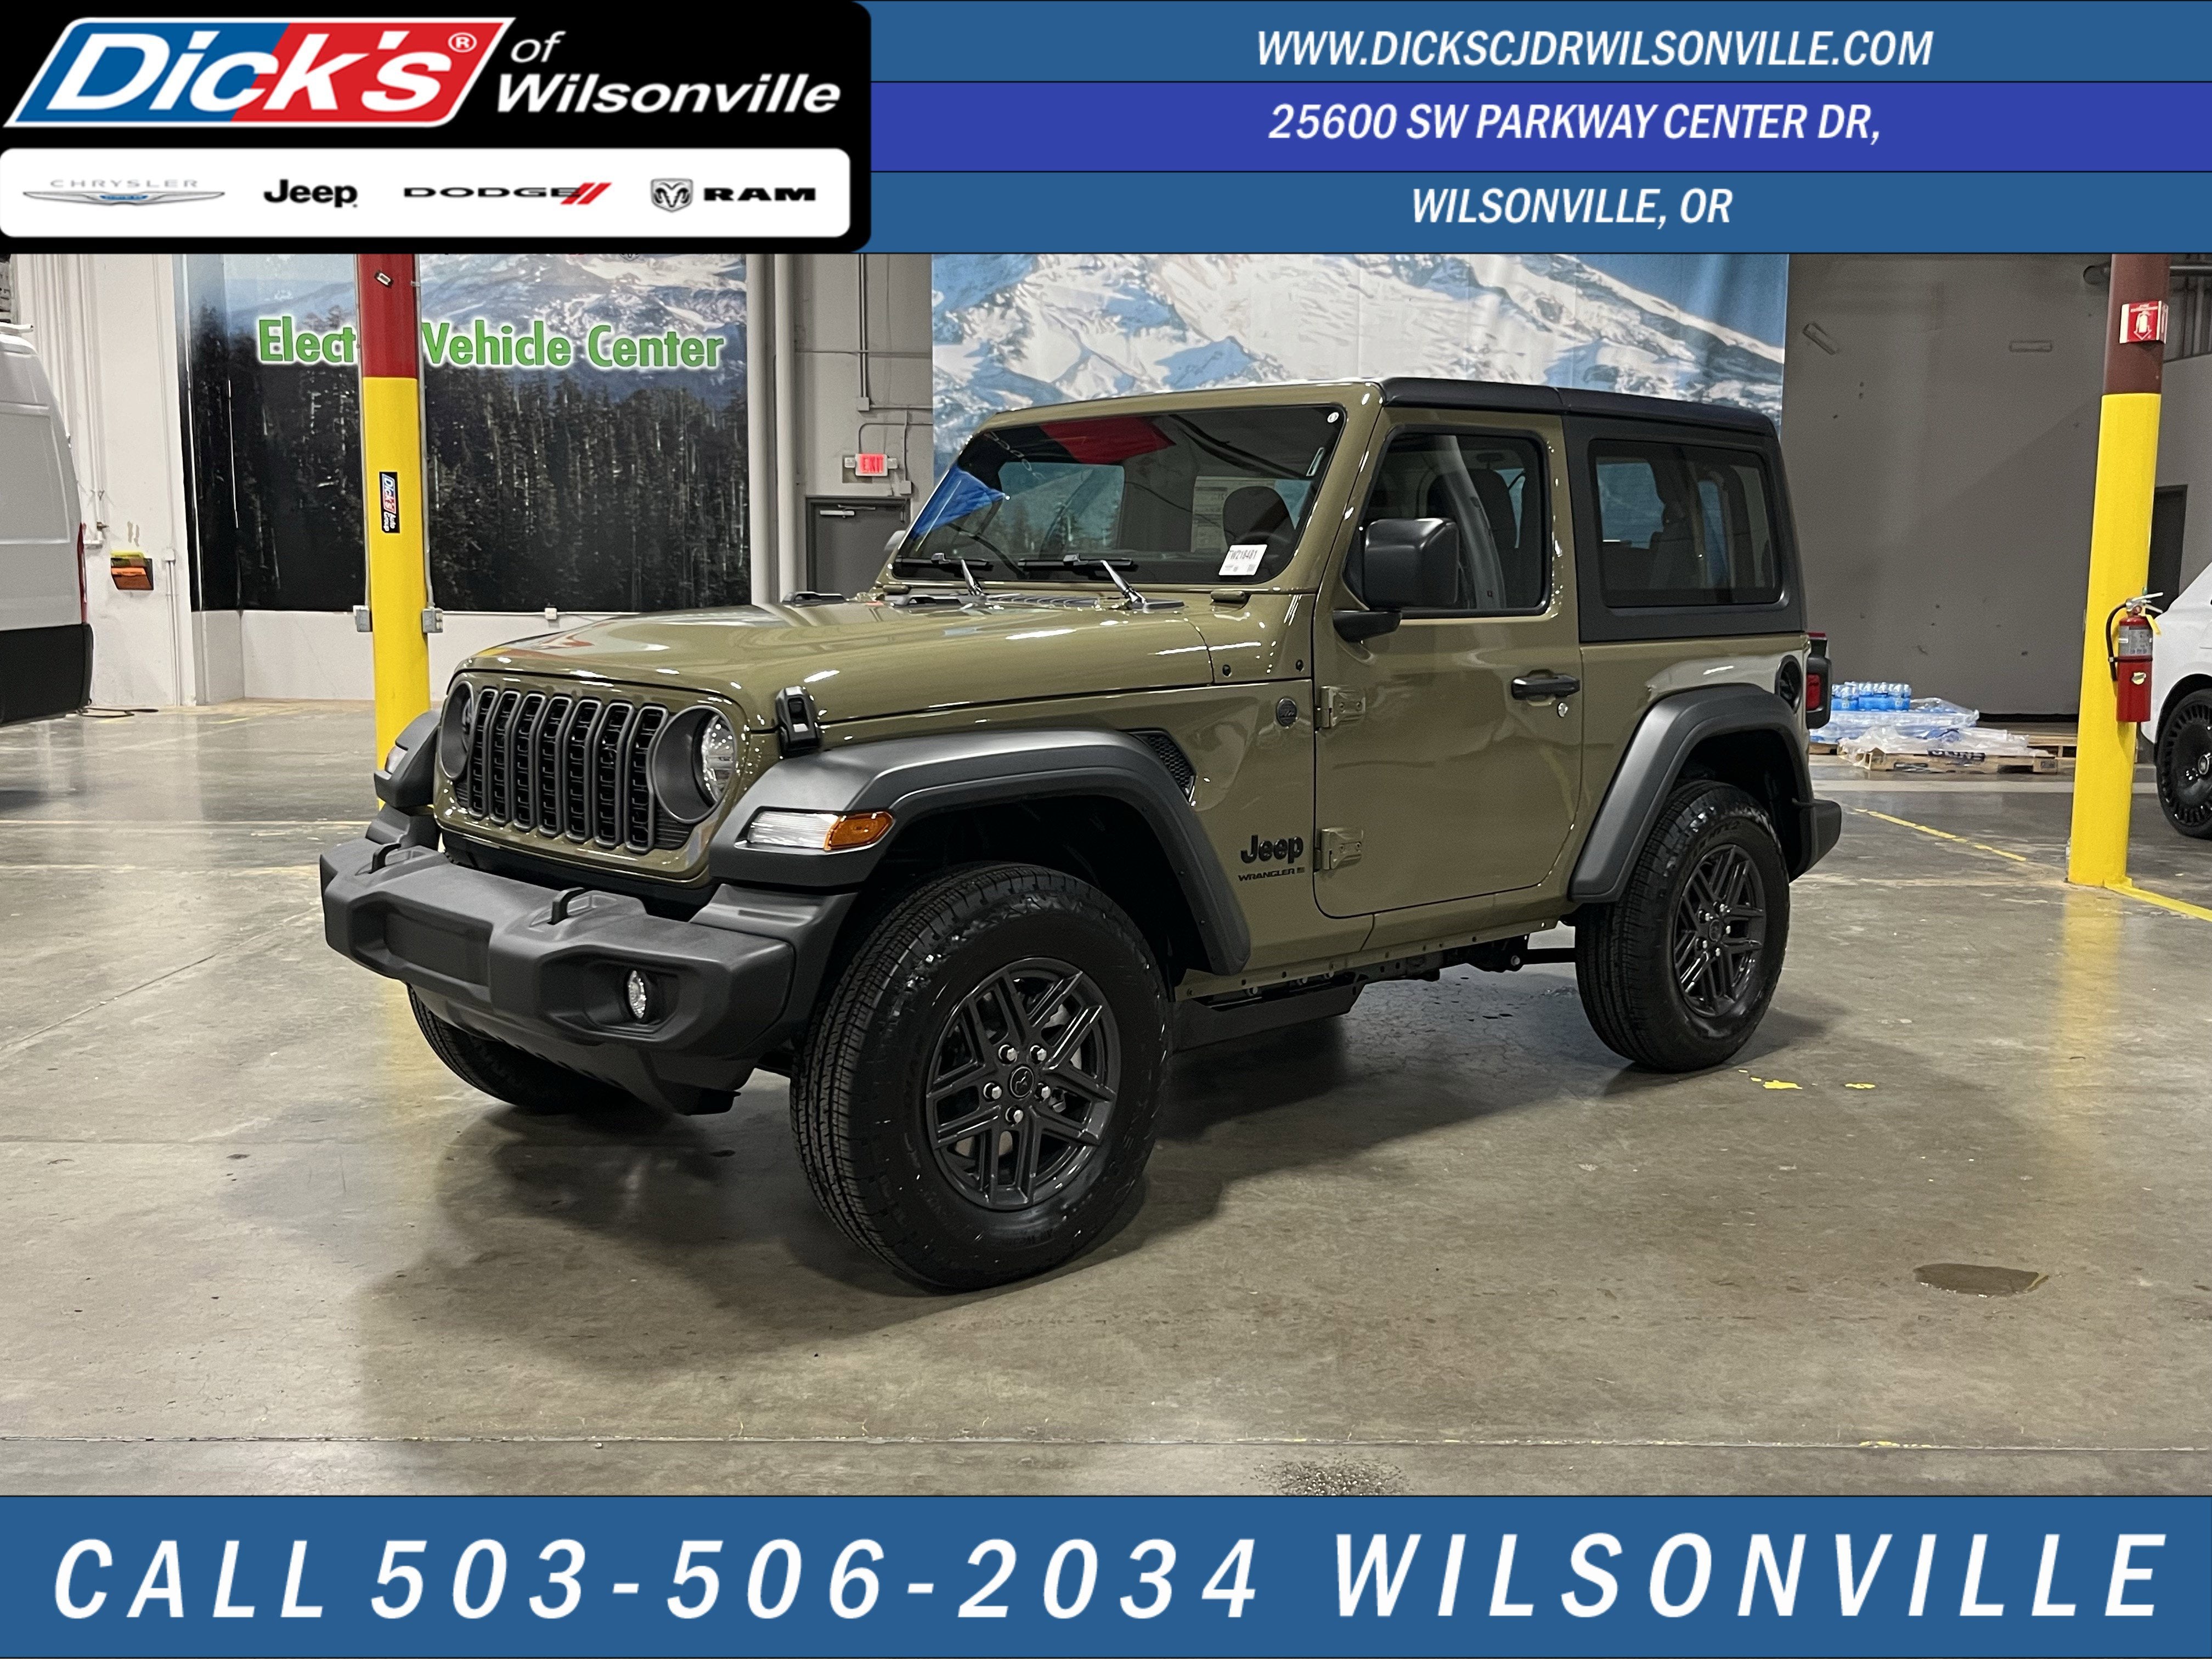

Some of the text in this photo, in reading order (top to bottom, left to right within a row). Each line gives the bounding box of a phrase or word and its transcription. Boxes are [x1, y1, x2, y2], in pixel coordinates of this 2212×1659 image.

[259, 316, 724, 368] Elect Vehicle Center
[862, 455, 884, 473] EXIT
[1240, 834, 1304, 864] Jeep
[1237, 868, 1295, 882] WRANGLER
